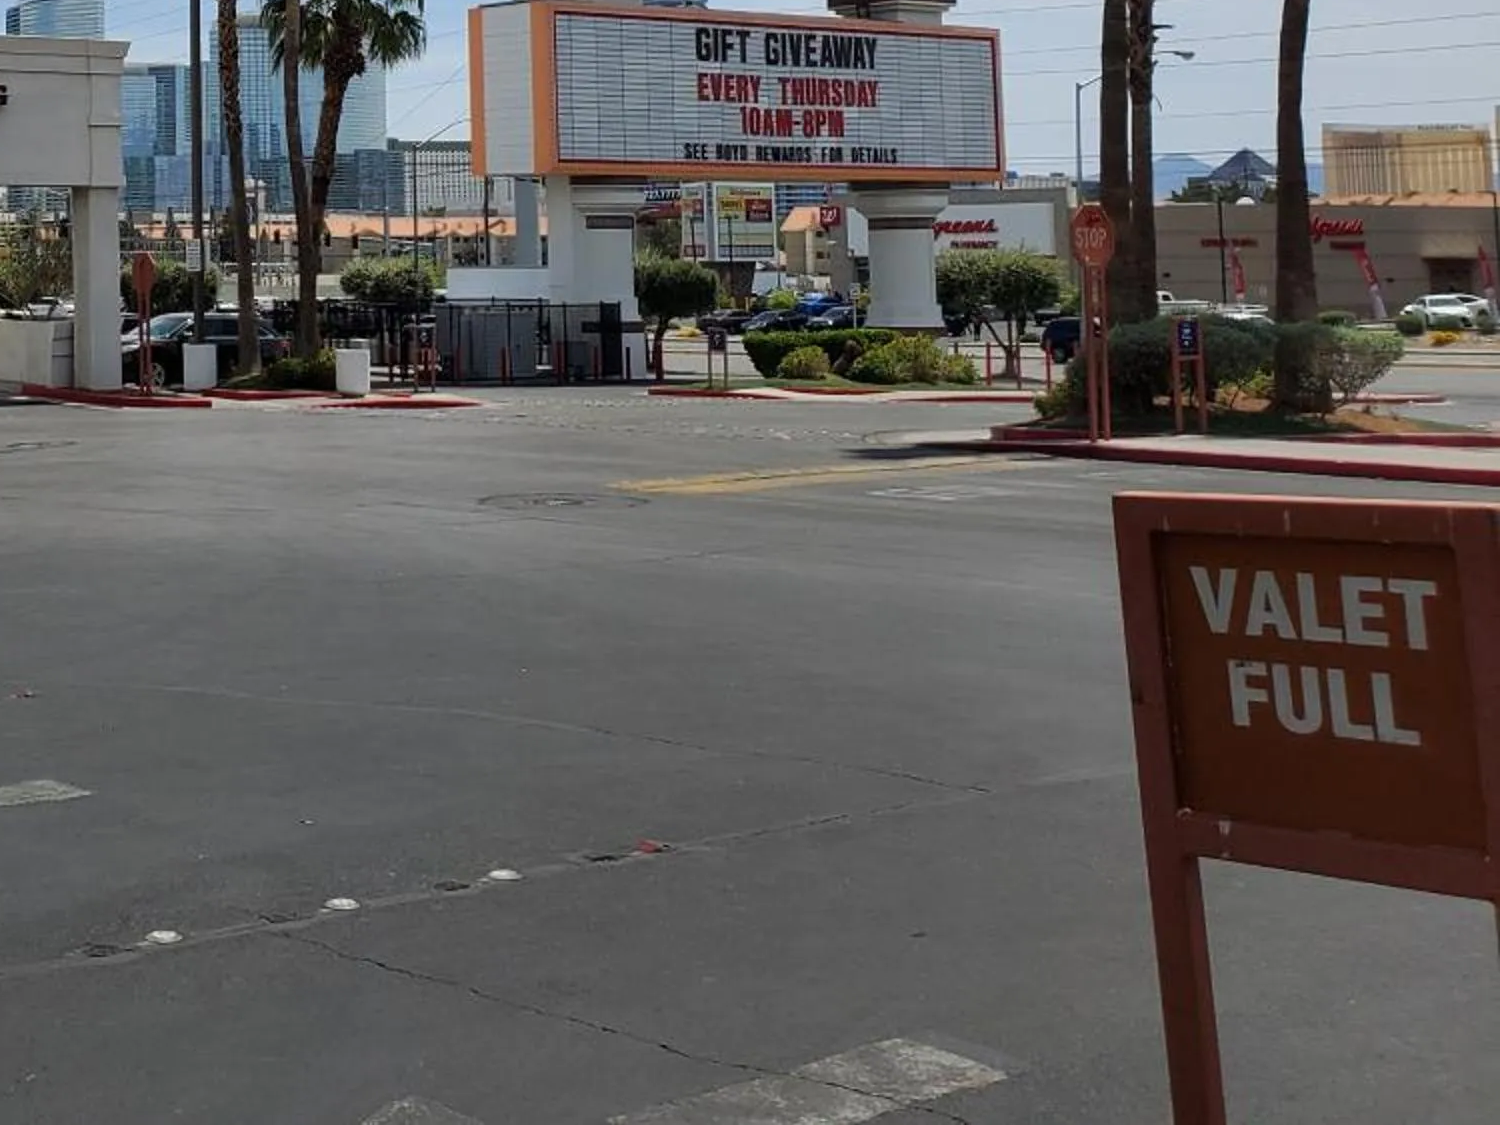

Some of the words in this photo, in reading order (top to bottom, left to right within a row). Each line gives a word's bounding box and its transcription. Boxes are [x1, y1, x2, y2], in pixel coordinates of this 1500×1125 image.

[695, 27, 750, 63] GIFT
[764, 32, 877, 69] GIVEAWAY
[697, 73, 761, 103] EVERY
[778, 77, 878, 107] THURSDAY
[740, 106, 845, 138] 10AM-8PM
[684, 143, 709, 160] SEE
[821, 146, 843, 162] FOR
[851, 146, 898, 164] DETAILS
[1075, 227, 1107, 249] STOP
[1189, 566, 1436, 650] VALET
[1227, 659, 1421, 746] FULL
